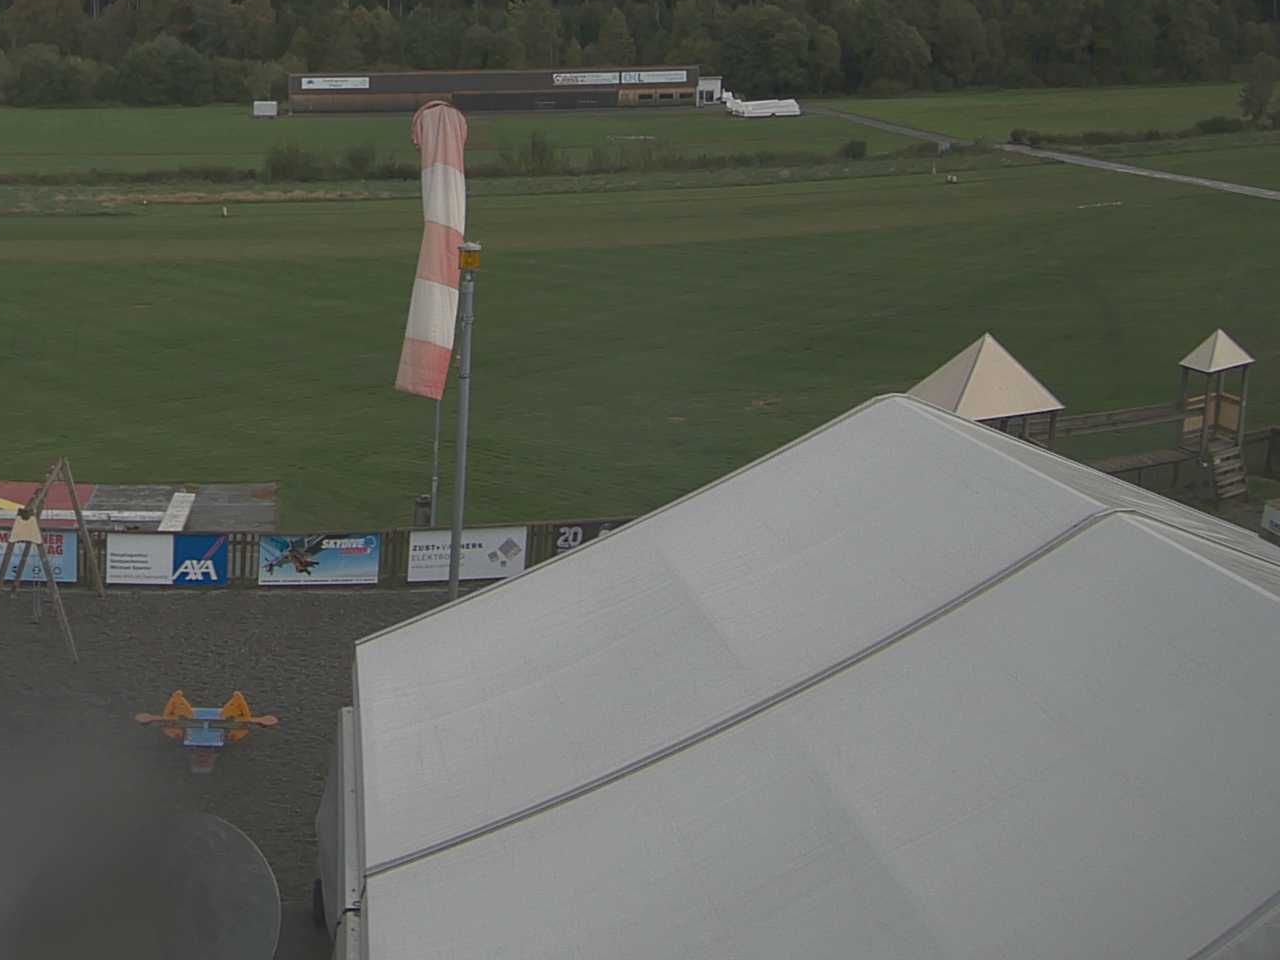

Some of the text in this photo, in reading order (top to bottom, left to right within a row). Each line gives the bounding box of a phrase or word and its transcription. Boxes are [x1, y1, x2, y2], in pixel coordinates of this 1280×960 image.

[556, 526, 583, 547] 20
[47, 545, 64, 555] AG
[172, 559, 218, 580] AXA
